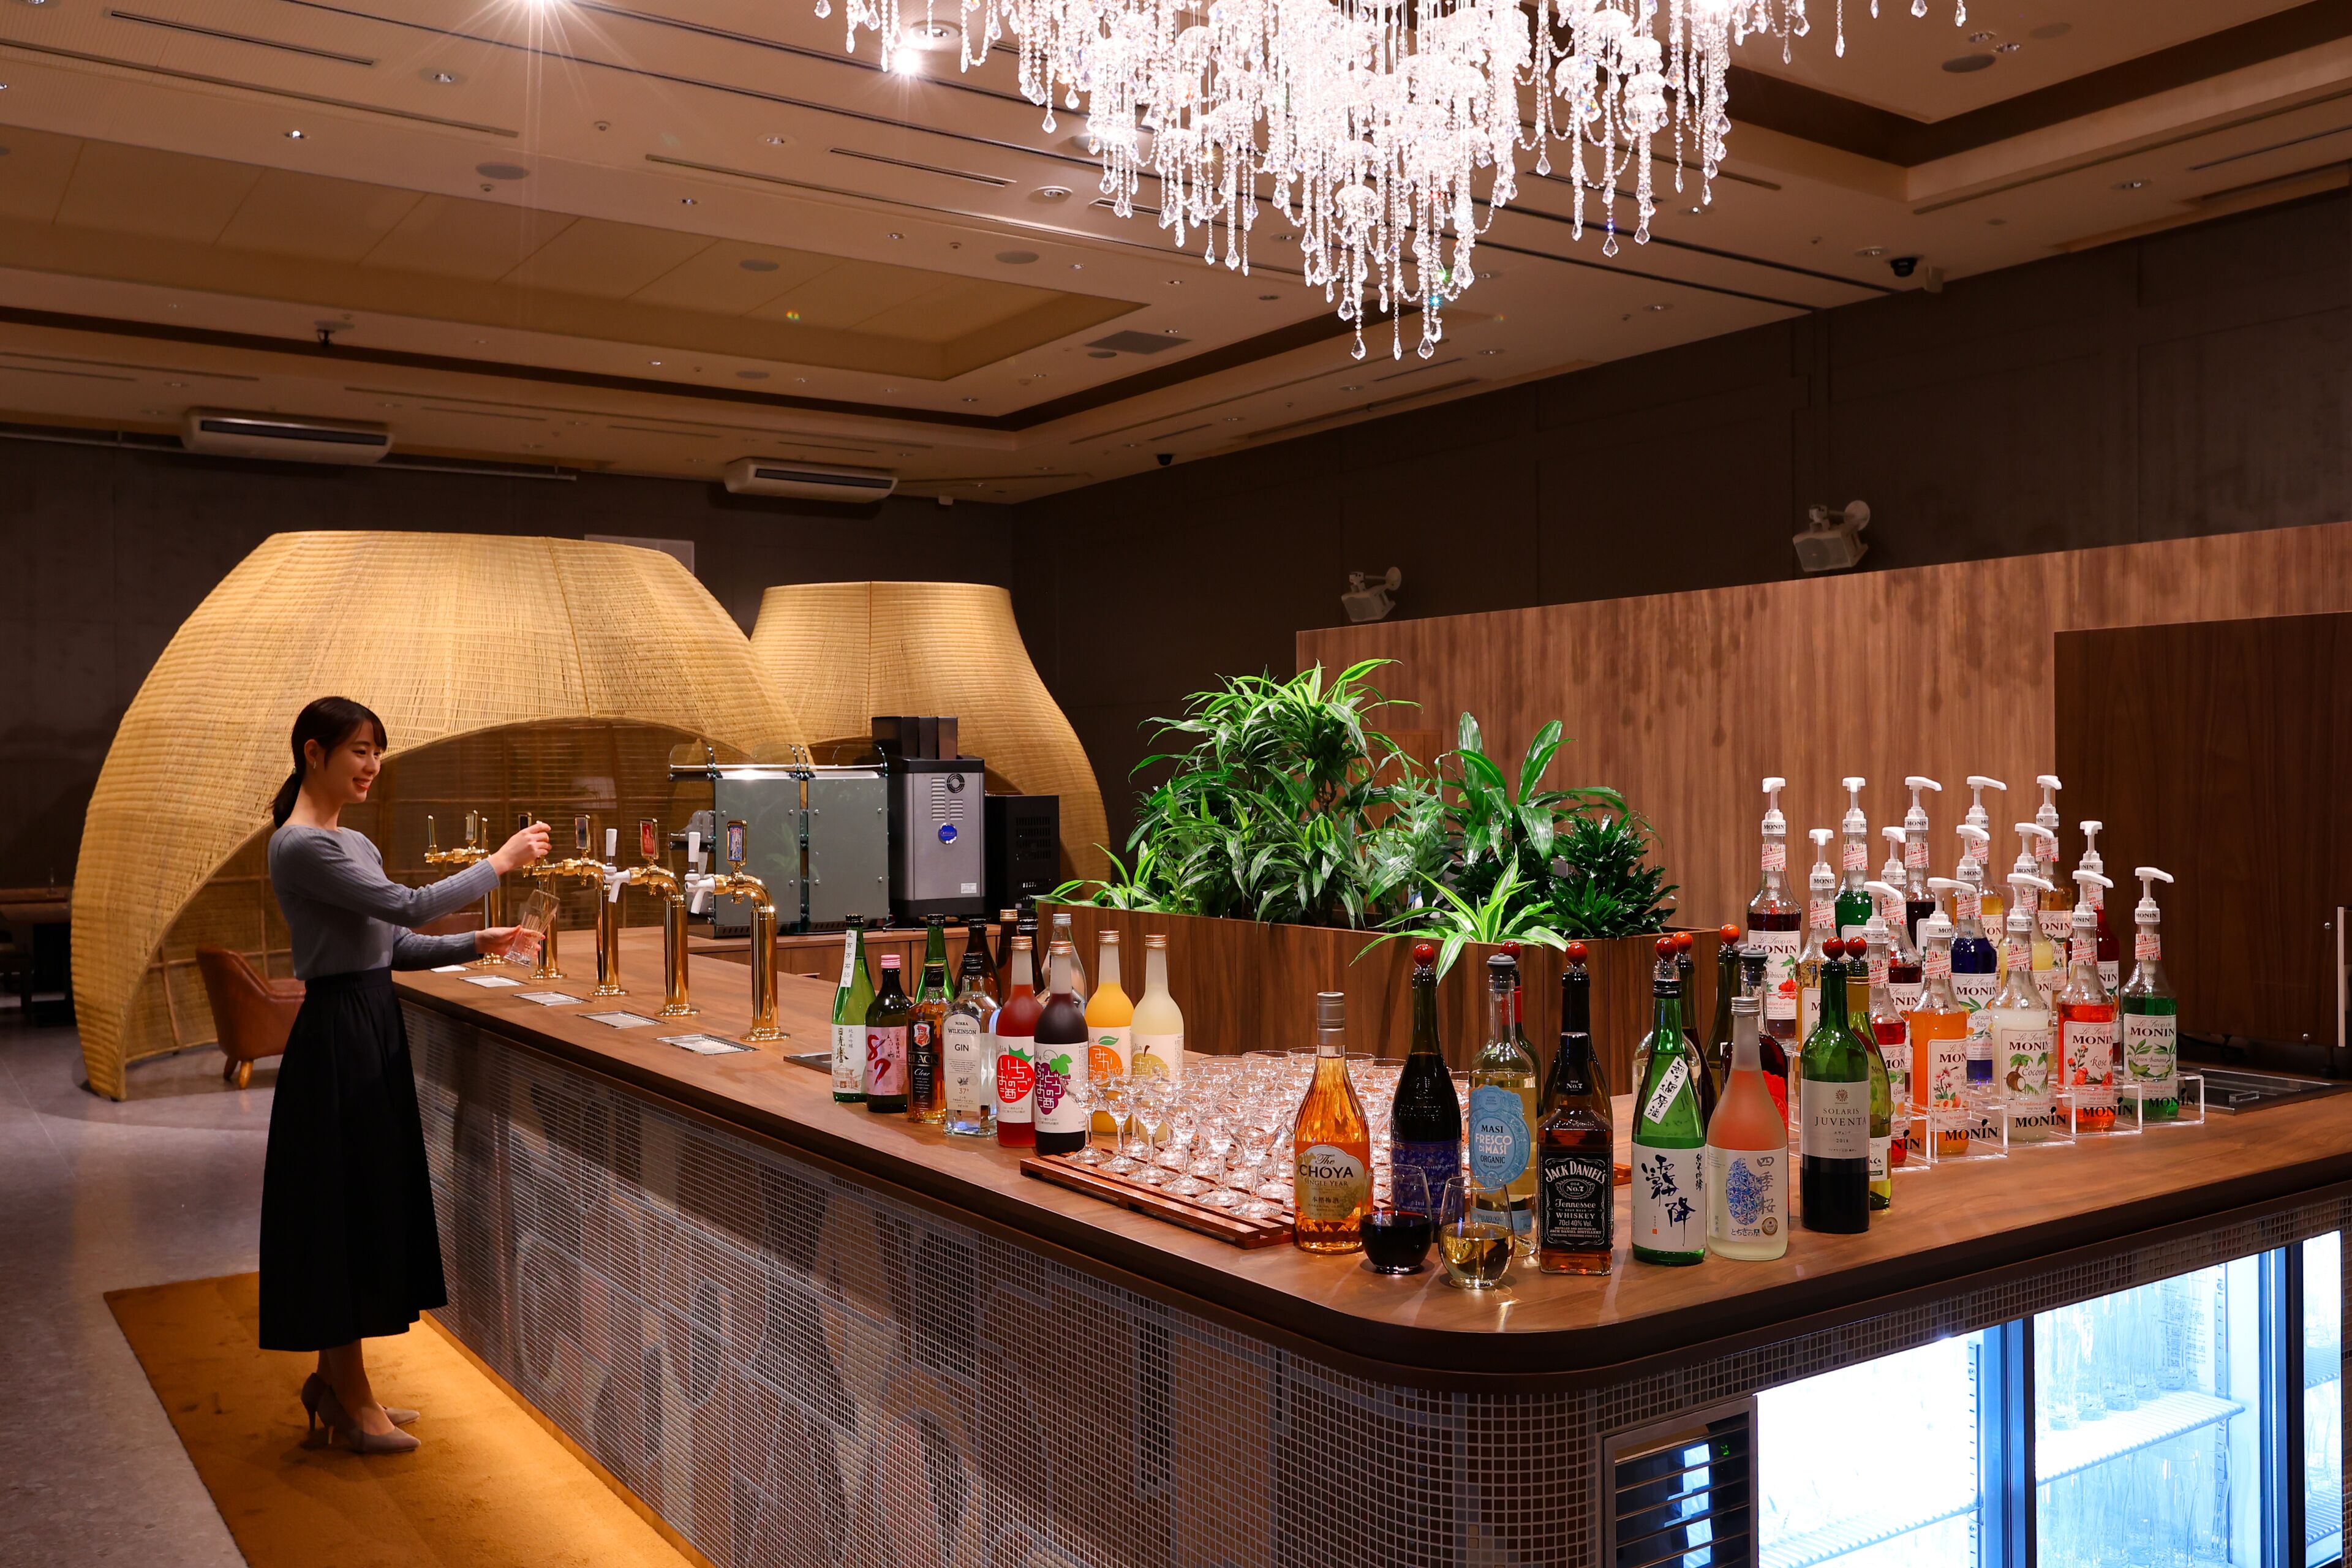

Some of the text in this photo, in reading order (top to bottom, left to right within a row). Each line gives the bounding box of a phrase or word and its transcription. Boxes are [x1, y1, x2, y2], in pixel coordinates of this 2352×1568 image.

[1770, 936, 1785, 946] Sirop
[1868, 974, 1888, 982] monin.co
[1974, 979, 1990, 987] Sirop
[2148, 1019, 2165, 1028] Sirop
[2130, 1027, 2174, 1037] MONIN
[1946, 1044, 1956, 1052] Le
[1939, 1054, 1966, 1063] MON
[2090, 1056, 2107, 1069] Rose
[1886, 1060, 1905, 1069] MON
[2149, 1088, 2195, 1108] MONIN
[2082, 1098, 2132, 1118] MONIN
[1814, 1116, 1867, 1126] JUVENTA
[2015, 1107, 2067, 1128] MONIN
[1481, 1125, 1504, 1133] MASI
[1945, 1120, 1998, 1141] MONIN
[1476, 1133, 1512, 1145] FRESCO
[1485, 1144, 1507, 1155] MASI
[1315, 1153, 1335, 1164] The
[1480, 1155, 1506, 1164] ORGANIC
[1299, 1164, 1354, 1178] CHOYA
[1545, 1161, 1607, 1184] JACK DANIEL'S
[1304, 1178, 1327, 1186] SINGLE
[1755, 1156, 1776, 1215] 四季桜
[1555, 1199, 1596, 1208] Tennessee
